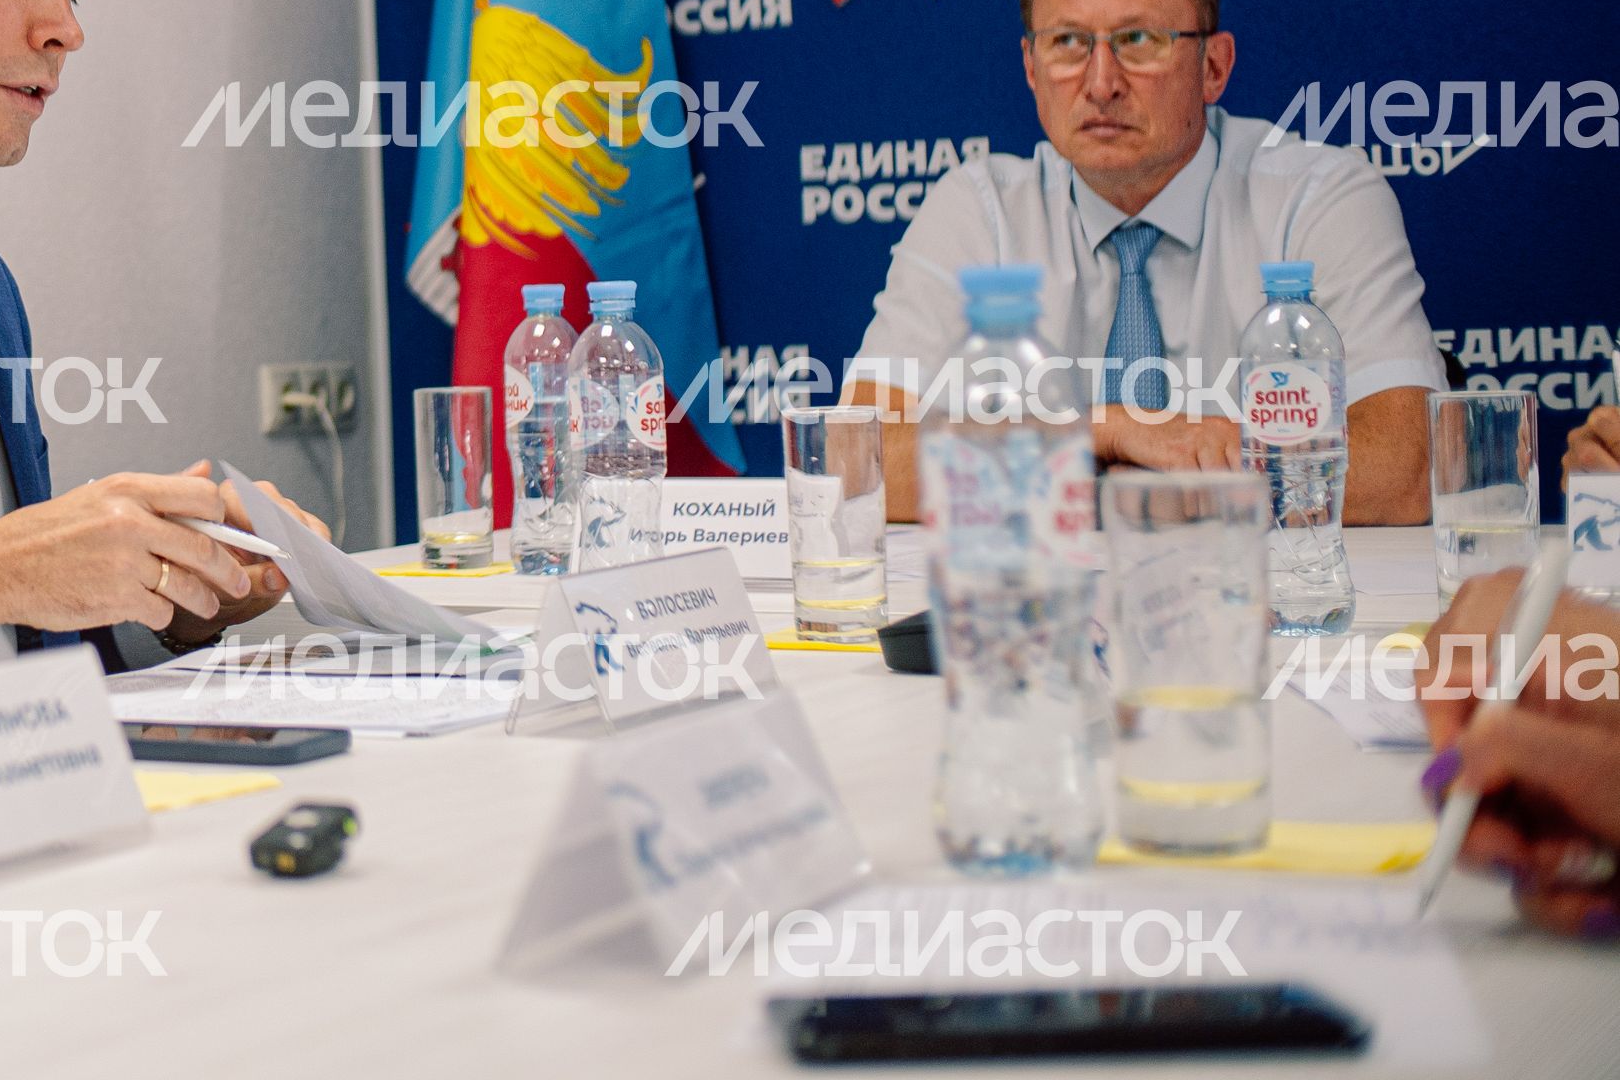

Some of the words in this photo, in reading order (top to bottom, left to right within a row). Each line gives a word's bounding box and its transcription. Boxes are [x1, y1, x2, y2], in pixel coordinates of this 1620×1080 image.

[802, 181, 936, 225] РОСС
[1433, 325, 1616, 368] ЕДИНА
[720, 344, 810, 380] НАЯ
[1255, 387, 1310, 405] saint
[1250, 407, 1318, 428] spring
[672, 499, 776, 517] КОХАНЫЙ
[693, 528, 789, 546] Валериев
[635, 587, 718, 620] ВОЛОСЕВИЧ
